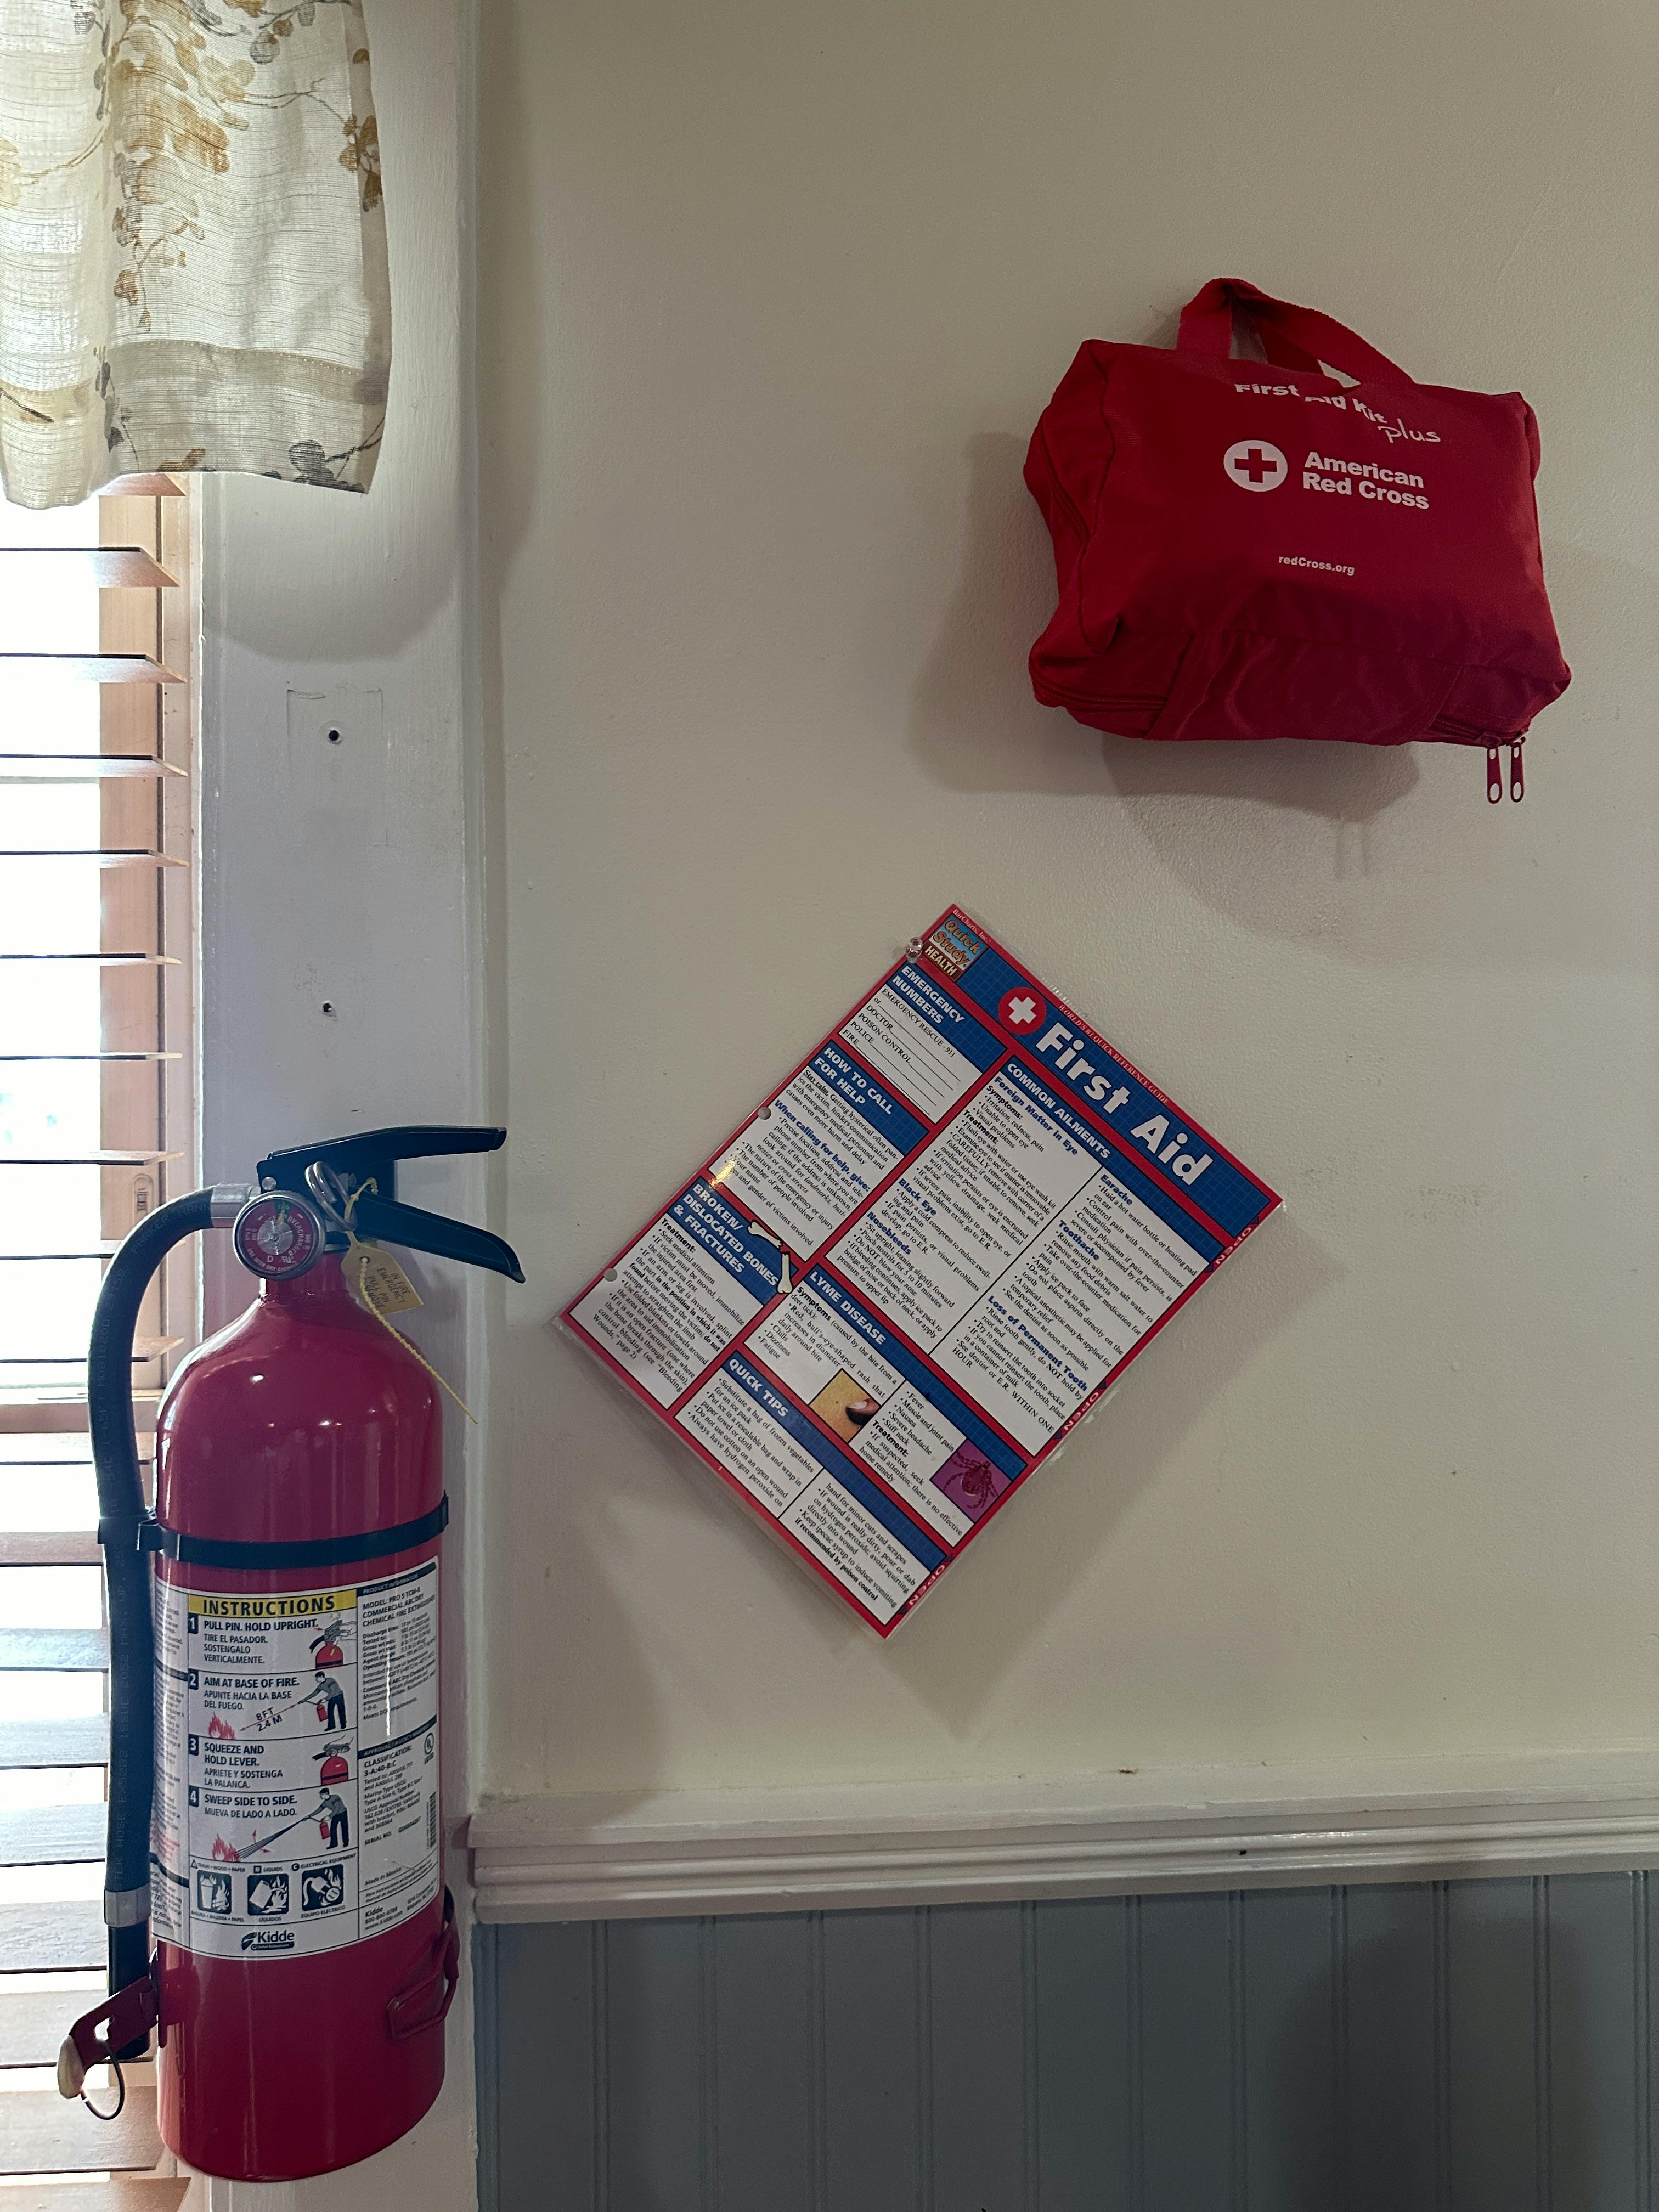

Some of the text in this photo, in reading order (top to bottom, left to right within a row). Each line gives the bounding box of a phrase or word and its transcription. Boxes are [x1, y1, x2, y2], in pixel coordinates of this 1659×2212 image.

[1234, 383, 1300, 397] First
[1377, 418, 1442, 443] plus
[1304, 452, 1424, 488] American
[1303, 472, 1430, 510] Red Cross
[1278, 556, 1355, 576] redCross.org
[941, 916, 984, 956] Quick
[952, 908, 991, 943] BarCharts, Inc.
[924, 945, 957, 976] HEALTH
[891, 975, 944, 1023] NUMBERS
[901, 965, 965, 1023] EMERGENCY
[865, 1004, 893, 1031] DOCTOR
[881, 988, 957, 1059] EMERGENCY RESCUE 911
[842, 1029, 859, 1046] FIRE
[850, 1020, 874, 1045] POLICE
[857, 1012, 911, 1064] POISON CONTROL
[1058, 1004, 1168, 1105] WORLD'S #1 QUICK REFERENCE GUIDE
[801, 1068, 818, 1085] Stay
[814, 1056, 865, 1104] FOR HELP
[823, 1047, 892, 1114] HOW TO CALL
[986, 1085, 1023, 1120] Symptoms:
[994, 1075, 1078, 1155] Foreign Matter in Eye
[1007, 1063, 1110, 1158] COMMON AILMENTS
[1035, 1022, 1214, 1186] First Aid
[963, 1109, 999, 1144] Treatment:
[774, 1099, 871, 1192] When calling for help, give:
[898, 1177, 936, 1216] Black Eye
[1099, 1173, 1132, 1205] Earache
[692, 1183, 743, 1231] BROKEN/
[661, 1217, 696, 1254] Treatment:
[673, 1204, 745, 1273] & FRACTURES
[682, 1193, 779, 1285] DISLOCATED BONES
[866, 1211, 911, 1255] Nosebleeds
[1058, 1219, 1099, 1261] Toothache
[366, 1276, 391, 1302] PULL PIN
[377, 1268, 407, 1302] EMERGENCY
[397, 1282, 411, 1294] FIRE
[796, 1286, 832, 1321] Symptoms
[809, 1271, 886, 1345] LYME DISEASE
[765, 1330, 791, 1357] Dizziness
[772, 1324, 788, 1342] Chills
[987, 1295, 1087, 1391] Loss of Permanent Tooth
[759, 1337, 781, 1359] Fatigue
[729, 1358, 788, 1417] QUICK TIPS
[907, 1392, 924, 1409] Fever
[895, 1406, 916, 1427] Nausea
[872, 1419, 909, 1457] Treatment:
[883, 1419, 909, 1446] Stiff neck
[889, 1412, 932, 1455] Severe headache
[203, 1595, 335, 1616] INSTRUCTIONS
[363, 1598, 387, 1610] MODEL:
[389, 1594, 400, 1603] PRO
[363, 1602, 403, 1618] COMMERCIAL
[189, 1617, 319, 1632] 1 PULL PIN. HOLD UPRIGHT.
[363, 1613, 395, 1627] CHEMICAL
[204, 1633, 268, 1644] TIRE EL PASADOR.
[204, 1644, 251, 1654] SOSTENGALO
[204, 1654, 265, 1664] VERTICALMENTE.
[189, 1673, 300, 1688] 2 AIM AT BASE OF FIRE.
[204, 1690, 292, 1700] APUNTE HACIA LA BASE
[204, 1700, 245, 1710] DEL FUEGO.
[257, 1715, 283, 1732] 2.4 M
[189, 1737, 264, 1754] 3 SQUEEZE AND
[204, 1754, 260, 1767] HOLD LEVER.
[204, 1767, 284, 1779] APRIETE Y SOSTENGA
[204, 1778, 251, 1789] LA PALANCA.
[189, 1790, 298, 1806] 4 SWEEP SIDE TO SIDE.
[204, 1807, 297, 1818] MUEVA DE LADO A LADO.
[365, 1906, 383, 1918] Kidde
[257, 1930, 295, 1943] Kidde
